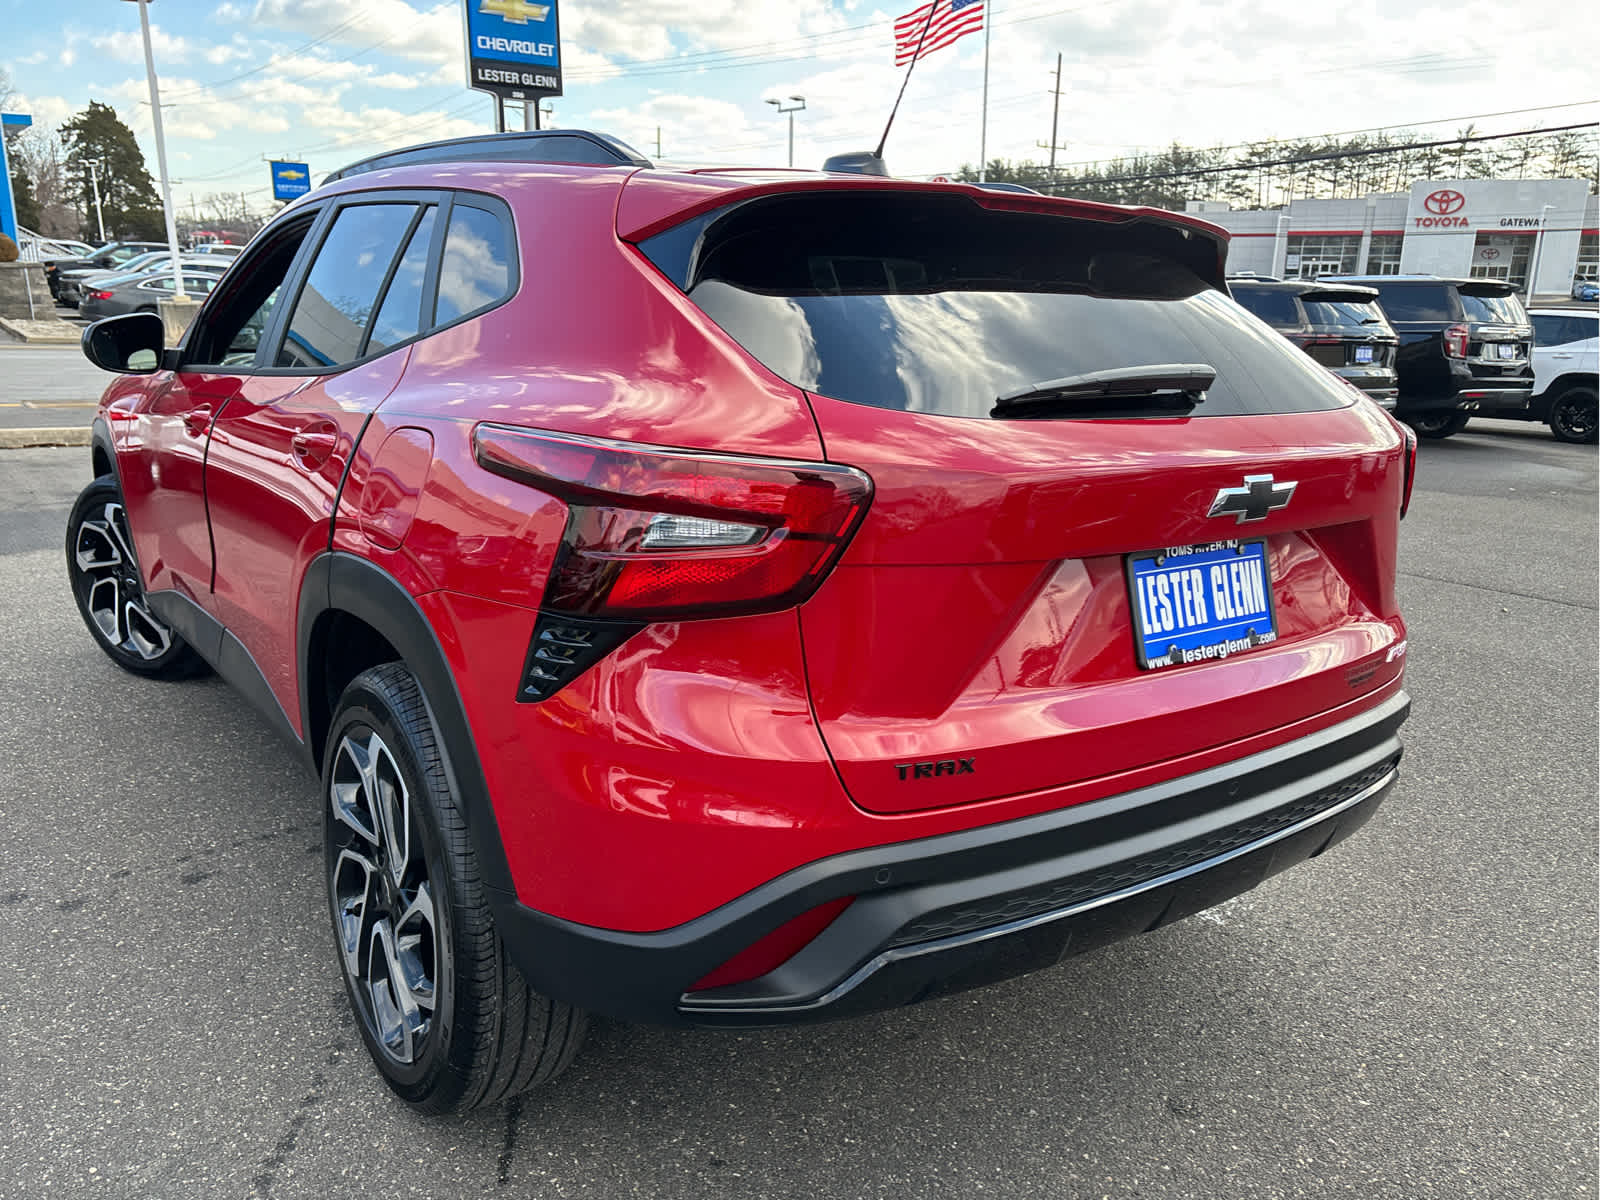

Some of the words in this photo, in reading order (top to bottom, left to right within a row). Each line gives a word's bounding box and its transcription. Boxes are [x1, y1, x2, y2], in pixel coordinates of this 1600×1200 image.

[477, 35, 555, 57] CHEVROLET
[478, 68, 519, 84] LESTER
[521, 73, 557, 88] GLENN
[1415, 217, 1469, 228] TOYOTA
[1165, 545, 1193, 558] TOMS
[1226, 539, 1238, 549] NJ
[1137, 568, 1208, 635] LESTER
[1210, 559, 1266, 621] GLENN
[894, 757, 976, 780] TRAX
